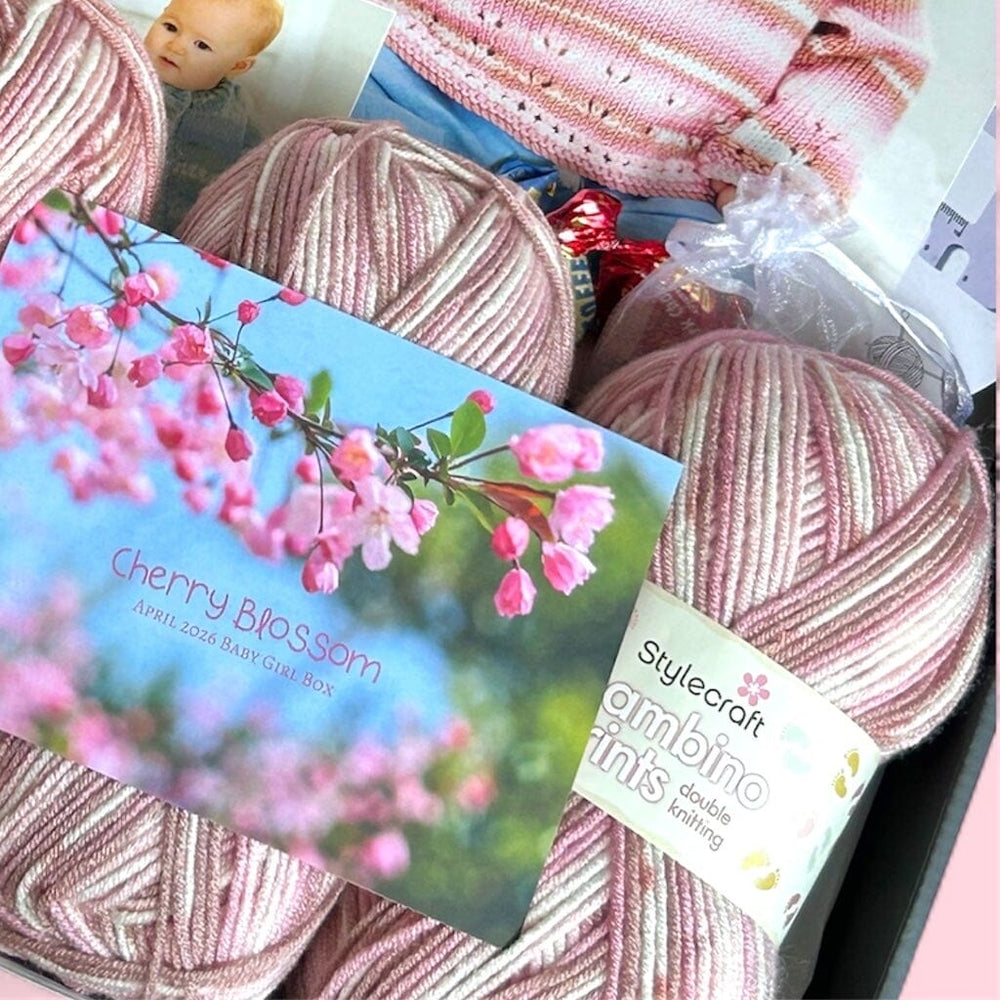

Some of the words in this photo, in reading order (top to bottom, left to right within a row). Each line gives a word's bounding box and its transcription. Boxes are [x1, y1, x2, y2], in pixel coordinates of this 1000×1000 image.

[111, 547, 229, 620] Cherry
[232, 597, 381, 684] Blossom
[179, 621, 218, 645] 2026
[637, 640, 767, 738] Stylecraft
[601, 680, 770, 811] ambino
[666, 799, 725, 851] knitting
[679, 782, 732, 826] double
